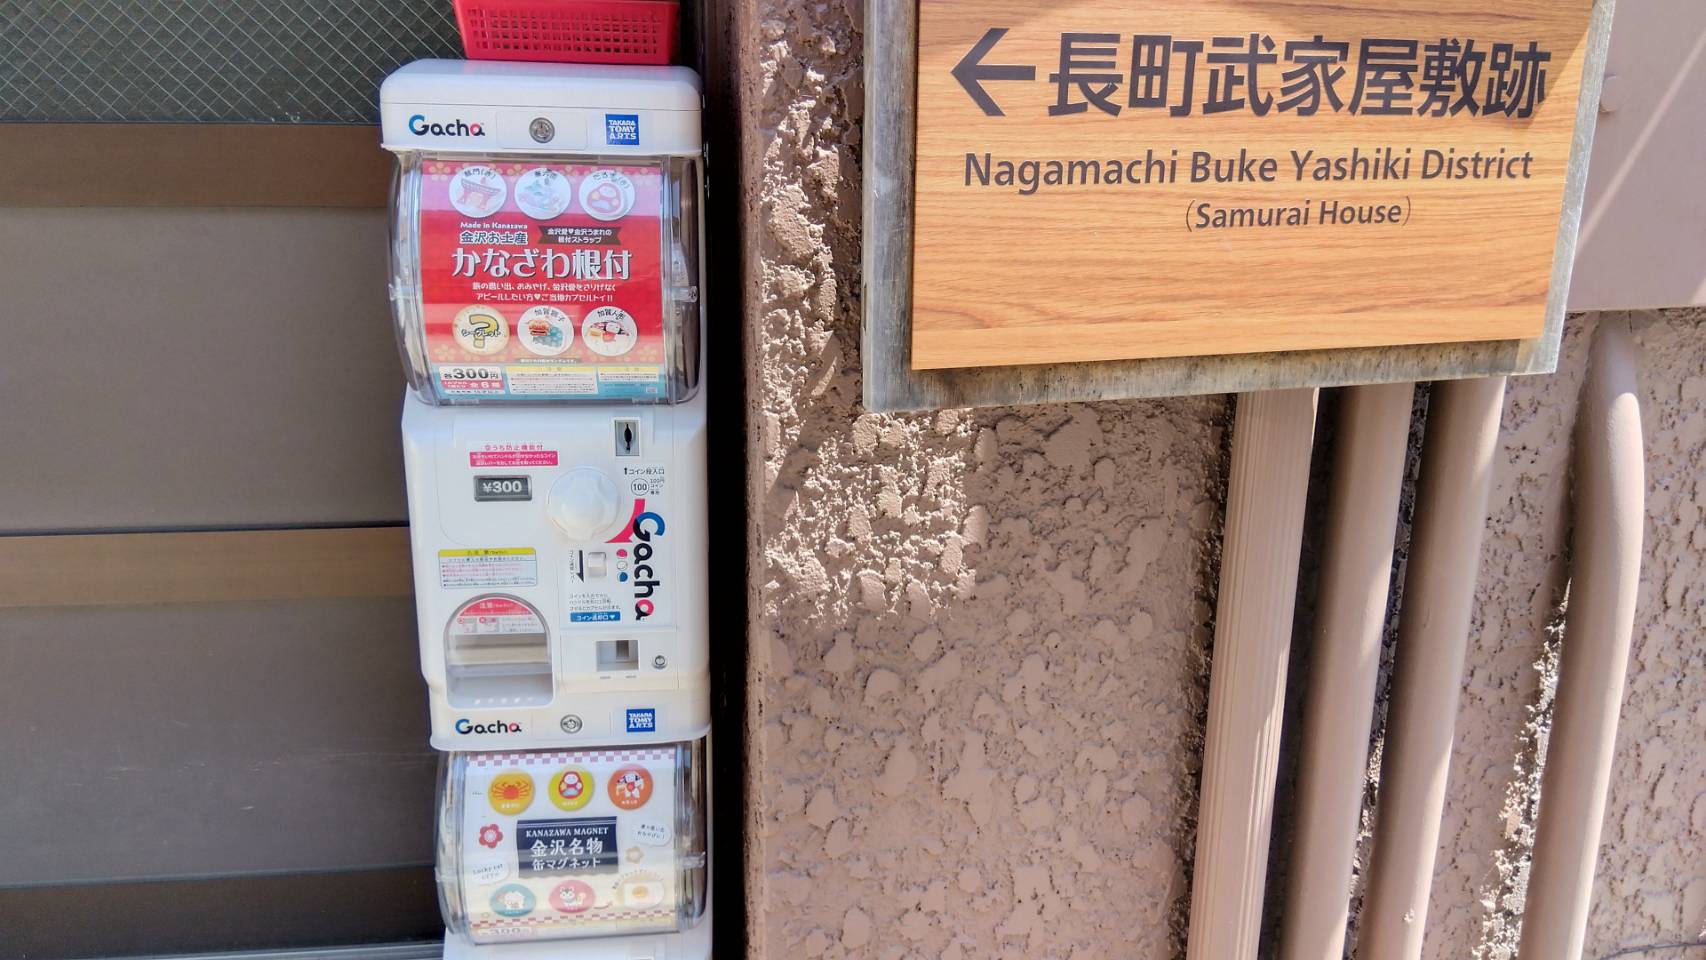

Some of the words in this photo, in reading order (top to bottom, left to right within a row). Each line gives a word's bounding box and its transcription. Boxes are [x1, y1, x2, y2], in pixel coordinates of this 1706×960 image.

[1048, 32, 1551, 118] 長町武家屋敷跡
[408, 114, 486, 137] Gacha
[609, 132, 637, 140] ARTS
[964, 149, 1178, 195] Nagamachi
[1191, 150, 1278, 182] Buke
[1290, 148, 1412, 181] Yashiki
[1422, 149, 1533, 179] District
[1186, 200, 1310, 232] (Samurai
[1319, 195, 1411, 227] House)
[459, 230, 529, 245] 金沢お土産
[451, 247, 633, 280] かなざわ根付
[482, 480, 523, 494] ¥300
[633, 483, 648, 491] 100
[632, 512, 666, 621] Gacha
[455, 718, 522, 735] Gacha
[526, 828, 572, 838] KANAZAWA
[574, 826, 609, 837] MAGNET
[530, 838, 603, 858] 金沢名物
[532, 857, 601, 871] 缶マグネット
